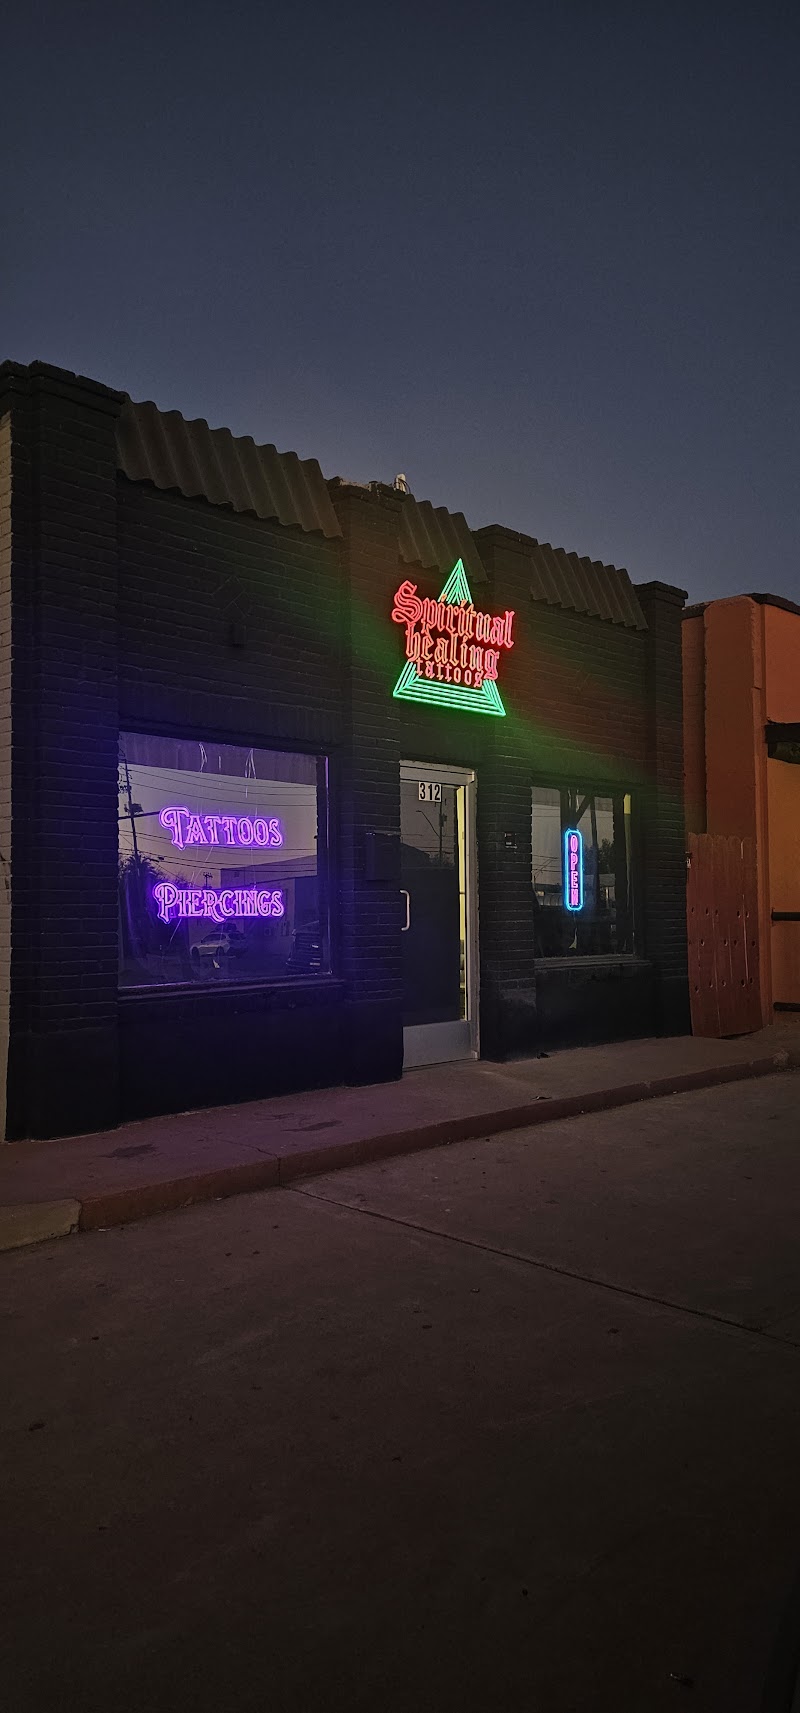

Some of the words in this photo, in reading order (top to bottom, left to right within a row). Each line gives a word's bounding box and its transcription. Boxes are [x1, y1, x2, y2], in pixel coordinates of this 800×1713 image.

[393, 580, 515, 648] Spiritual
[405, 623, 500, 681] healing
[415, 658, 484, 687] tattoos
[419, 782, 441, 801] 312
[160, 806, 283, 850] TATTOOS
[570, 834, 579, 906] OPEN
[154, 883, 284, 923] PIERCINGS
